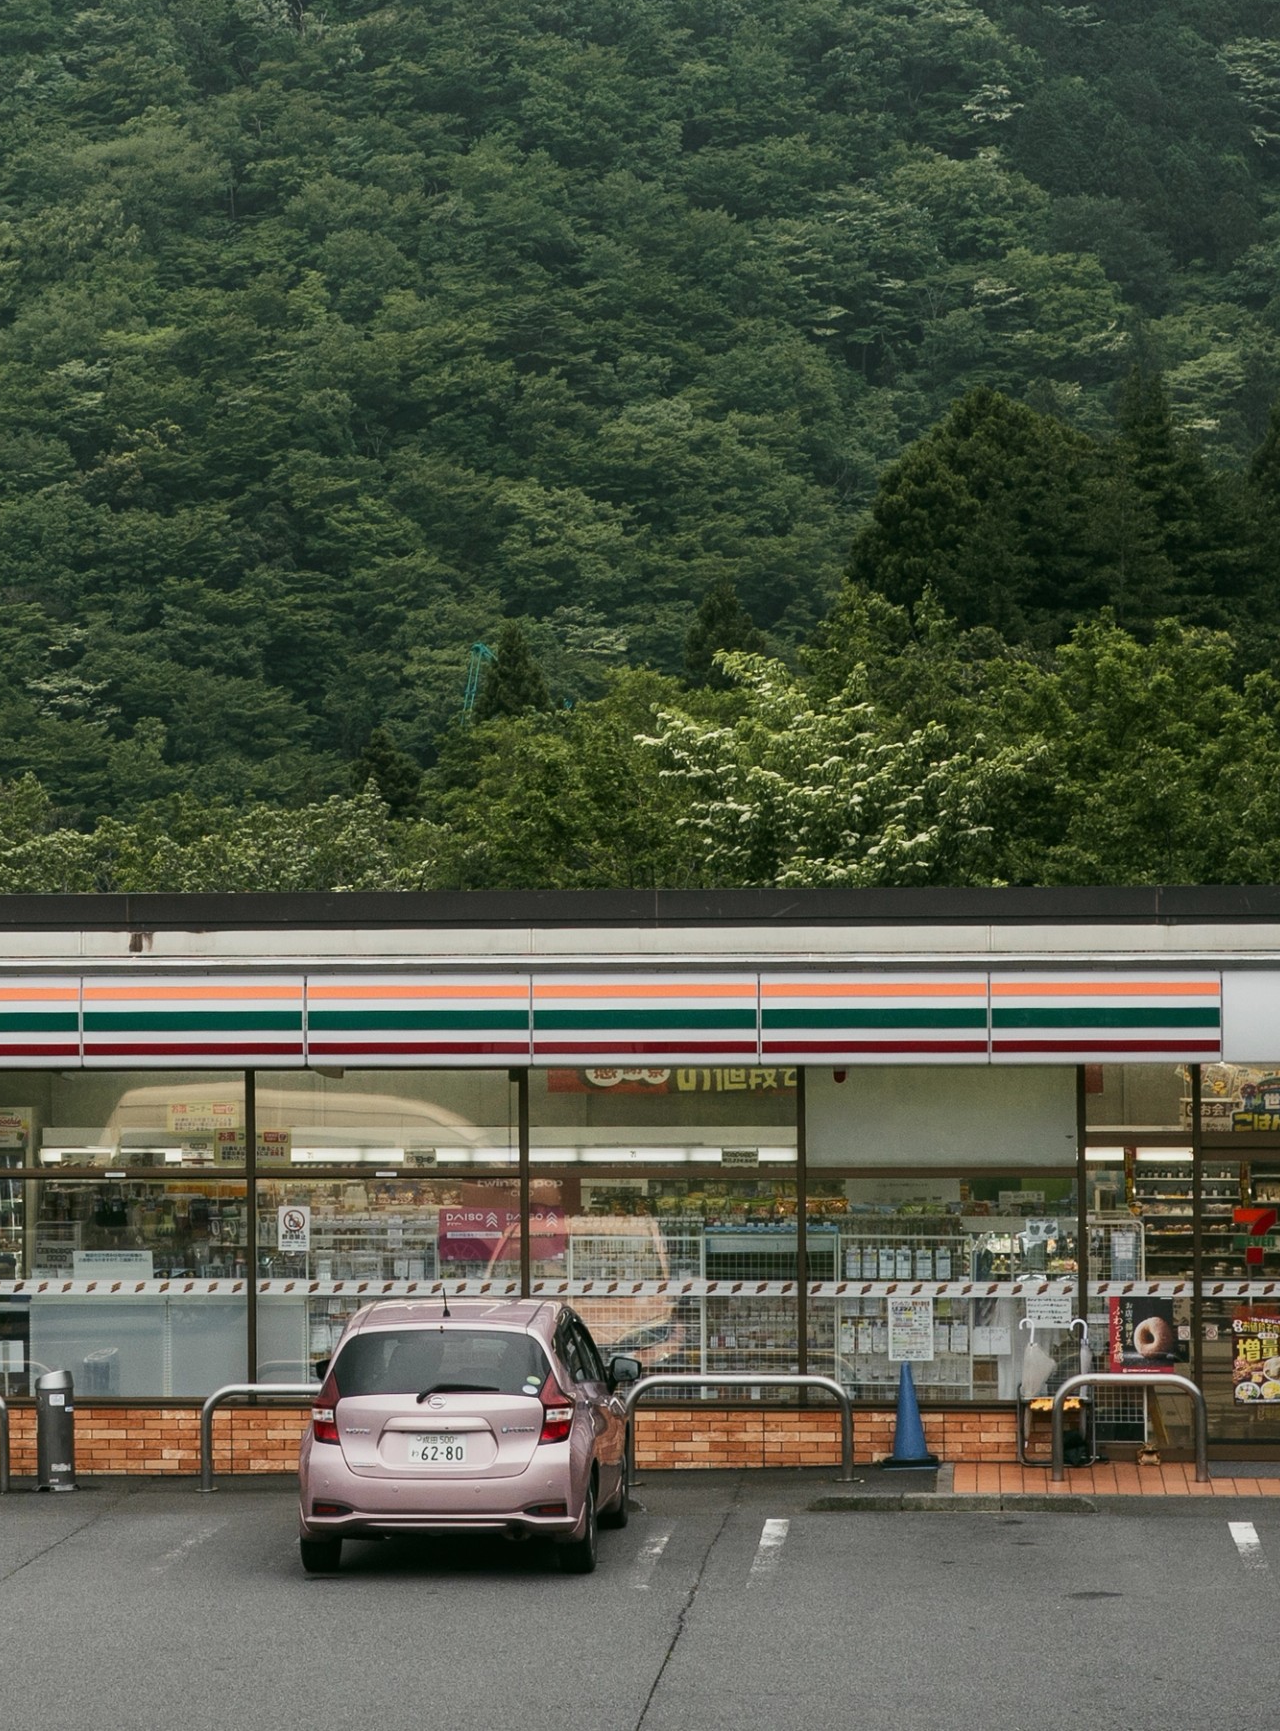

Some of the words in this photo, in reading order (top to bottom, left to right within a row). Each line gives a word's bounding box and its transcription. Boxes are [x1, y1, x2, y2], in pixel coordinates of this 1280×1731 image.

[446, 1213, 483, 1221] DAISO
[506, 1213, 543, 1221] DASO
[439, 1435, 455, 1444] 500
[421, 1446, 464, 1461] 62-80
